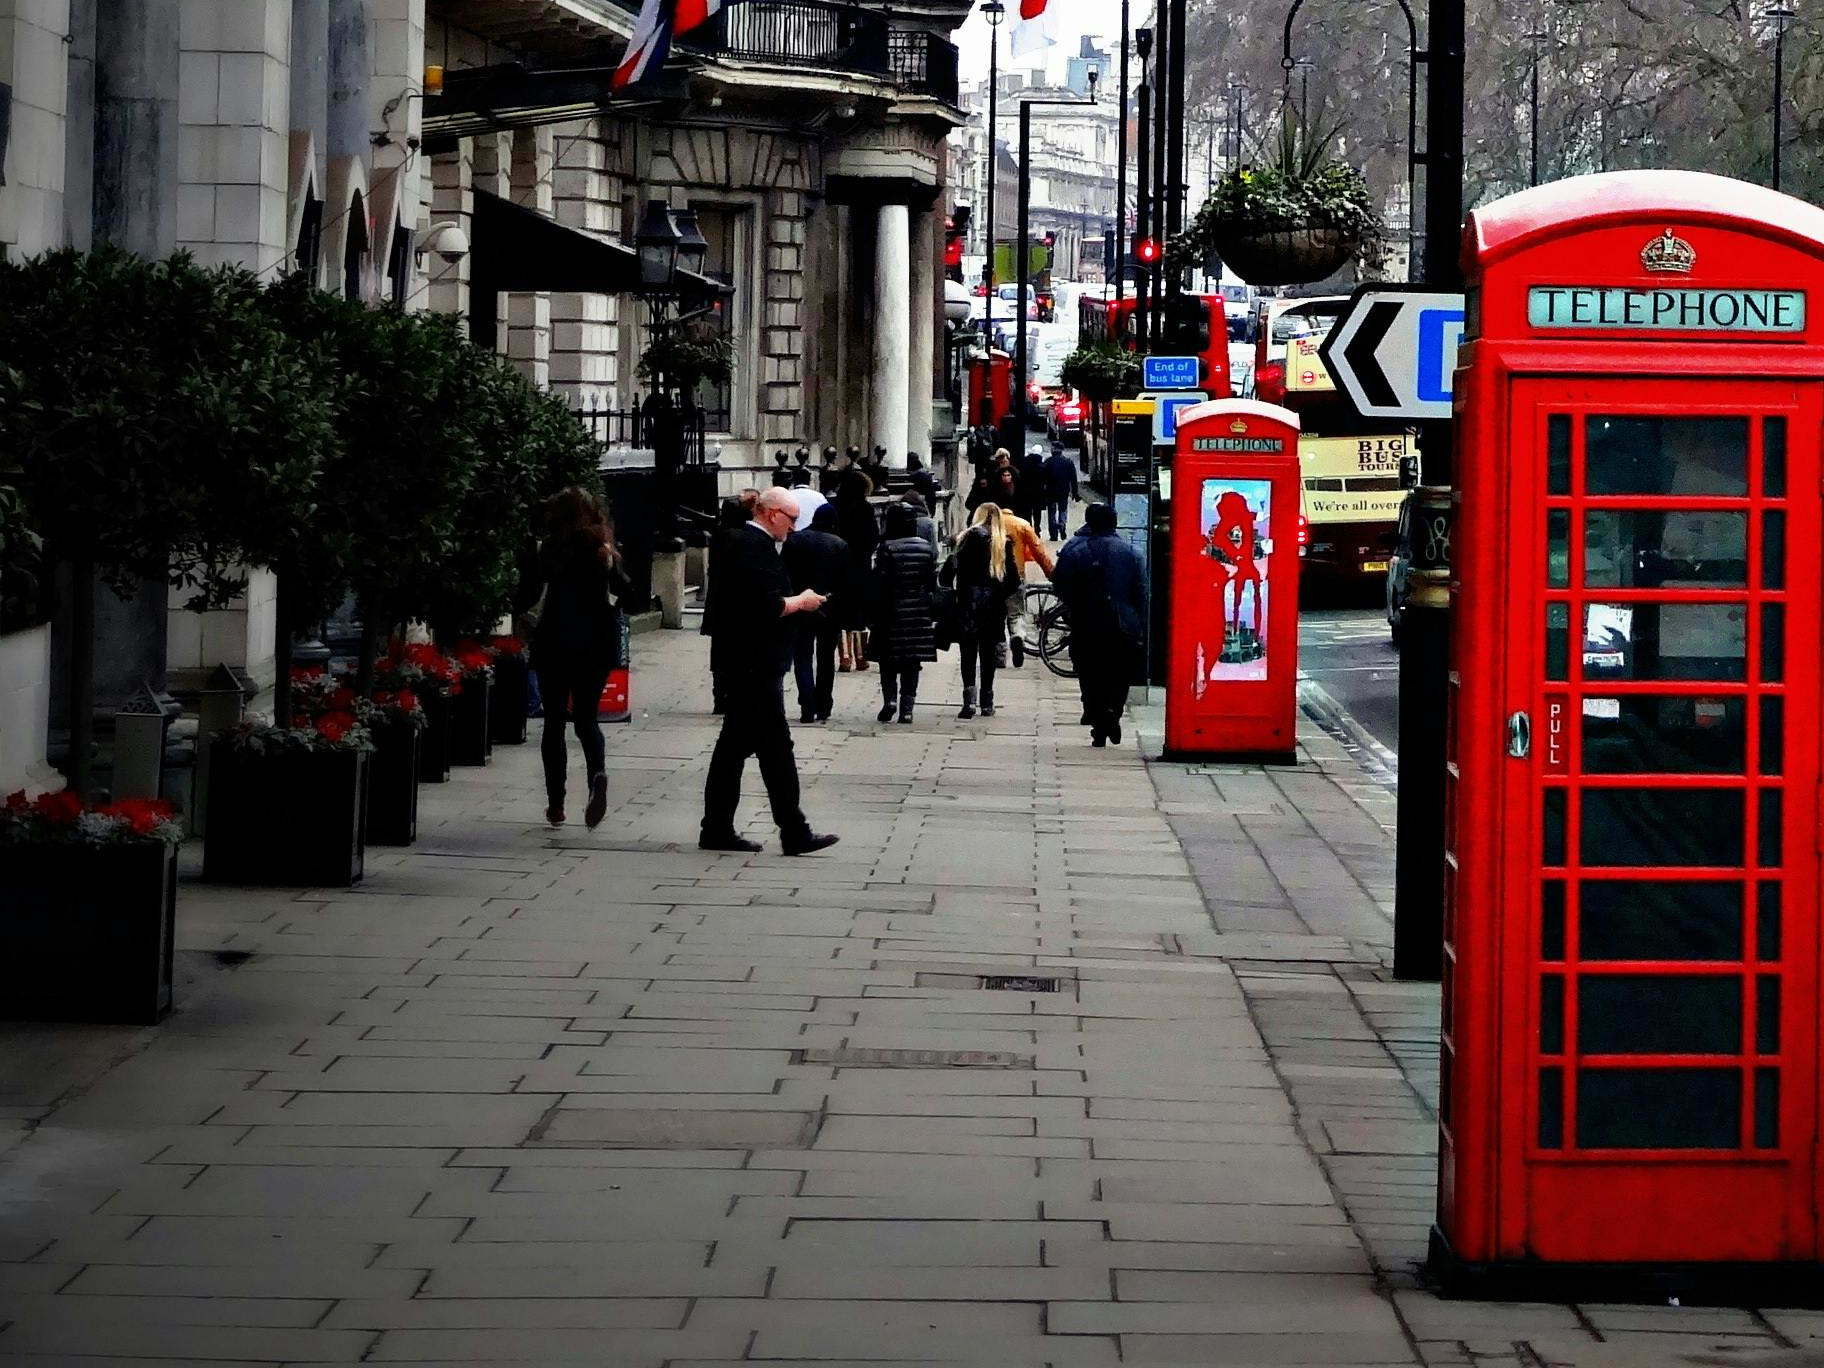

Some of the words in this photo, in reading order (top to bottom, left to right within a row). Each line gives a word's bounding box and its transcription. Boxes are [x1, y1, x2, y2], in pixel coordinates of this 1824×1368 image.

[1537, 289, 1795, 328] TELEPHONE
[1154, 362, 1174, 372] End
[1177, 362, 1189, 372] of
[1149, 374, 1168, 383] bus
[1171, 374, 1194, 383] lane
[1195, 438, 1281, 451] TELEPHONE
[1357, 439, 1402, 452] BIG
[1357, 451, 1402, 463] BUS
[1313, 500, 1349, 512] We're
[1352, 499, 1367, 511] all
[1371, 502, 1399, 511] over
[1550, 704, 1560, 764] PULL
